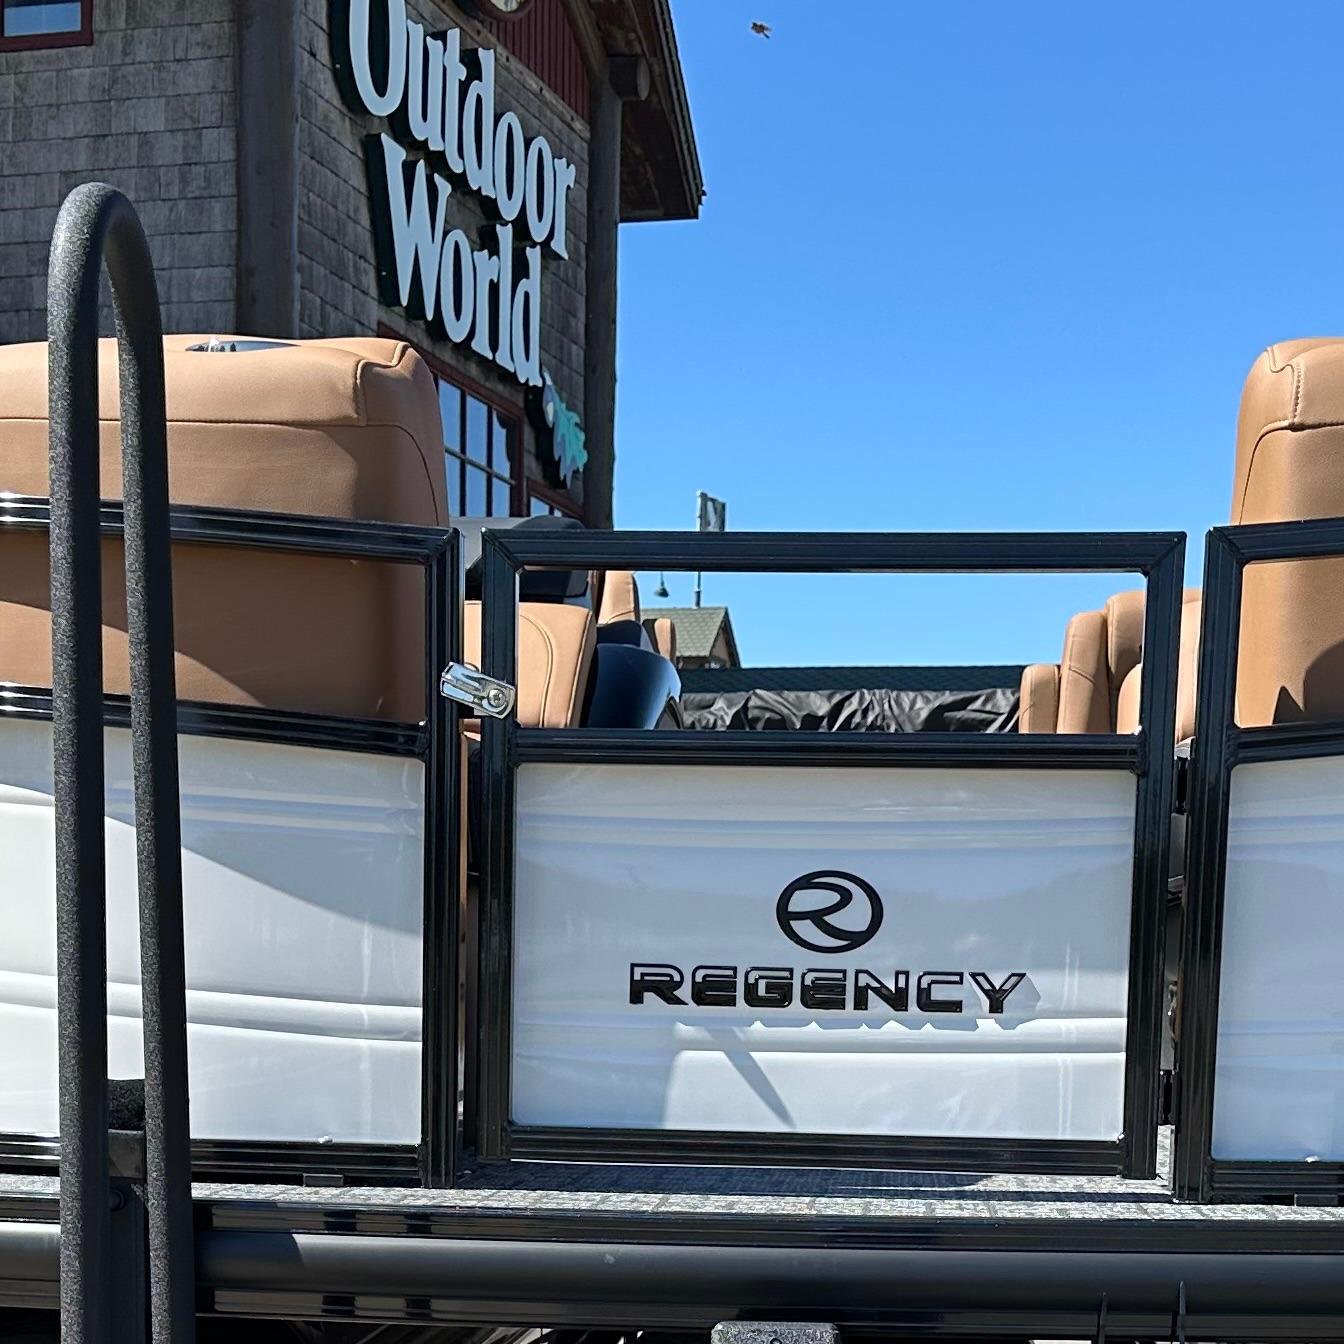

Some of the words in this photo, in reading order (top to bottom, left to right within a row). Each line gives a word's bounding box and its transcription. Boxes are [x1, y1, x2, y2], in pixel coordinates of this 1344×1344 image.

[349, 0, 576, 260] Outdoor
[380, 132, 544, 387] World
[629, 962, 1027, 1014] REGENCY
